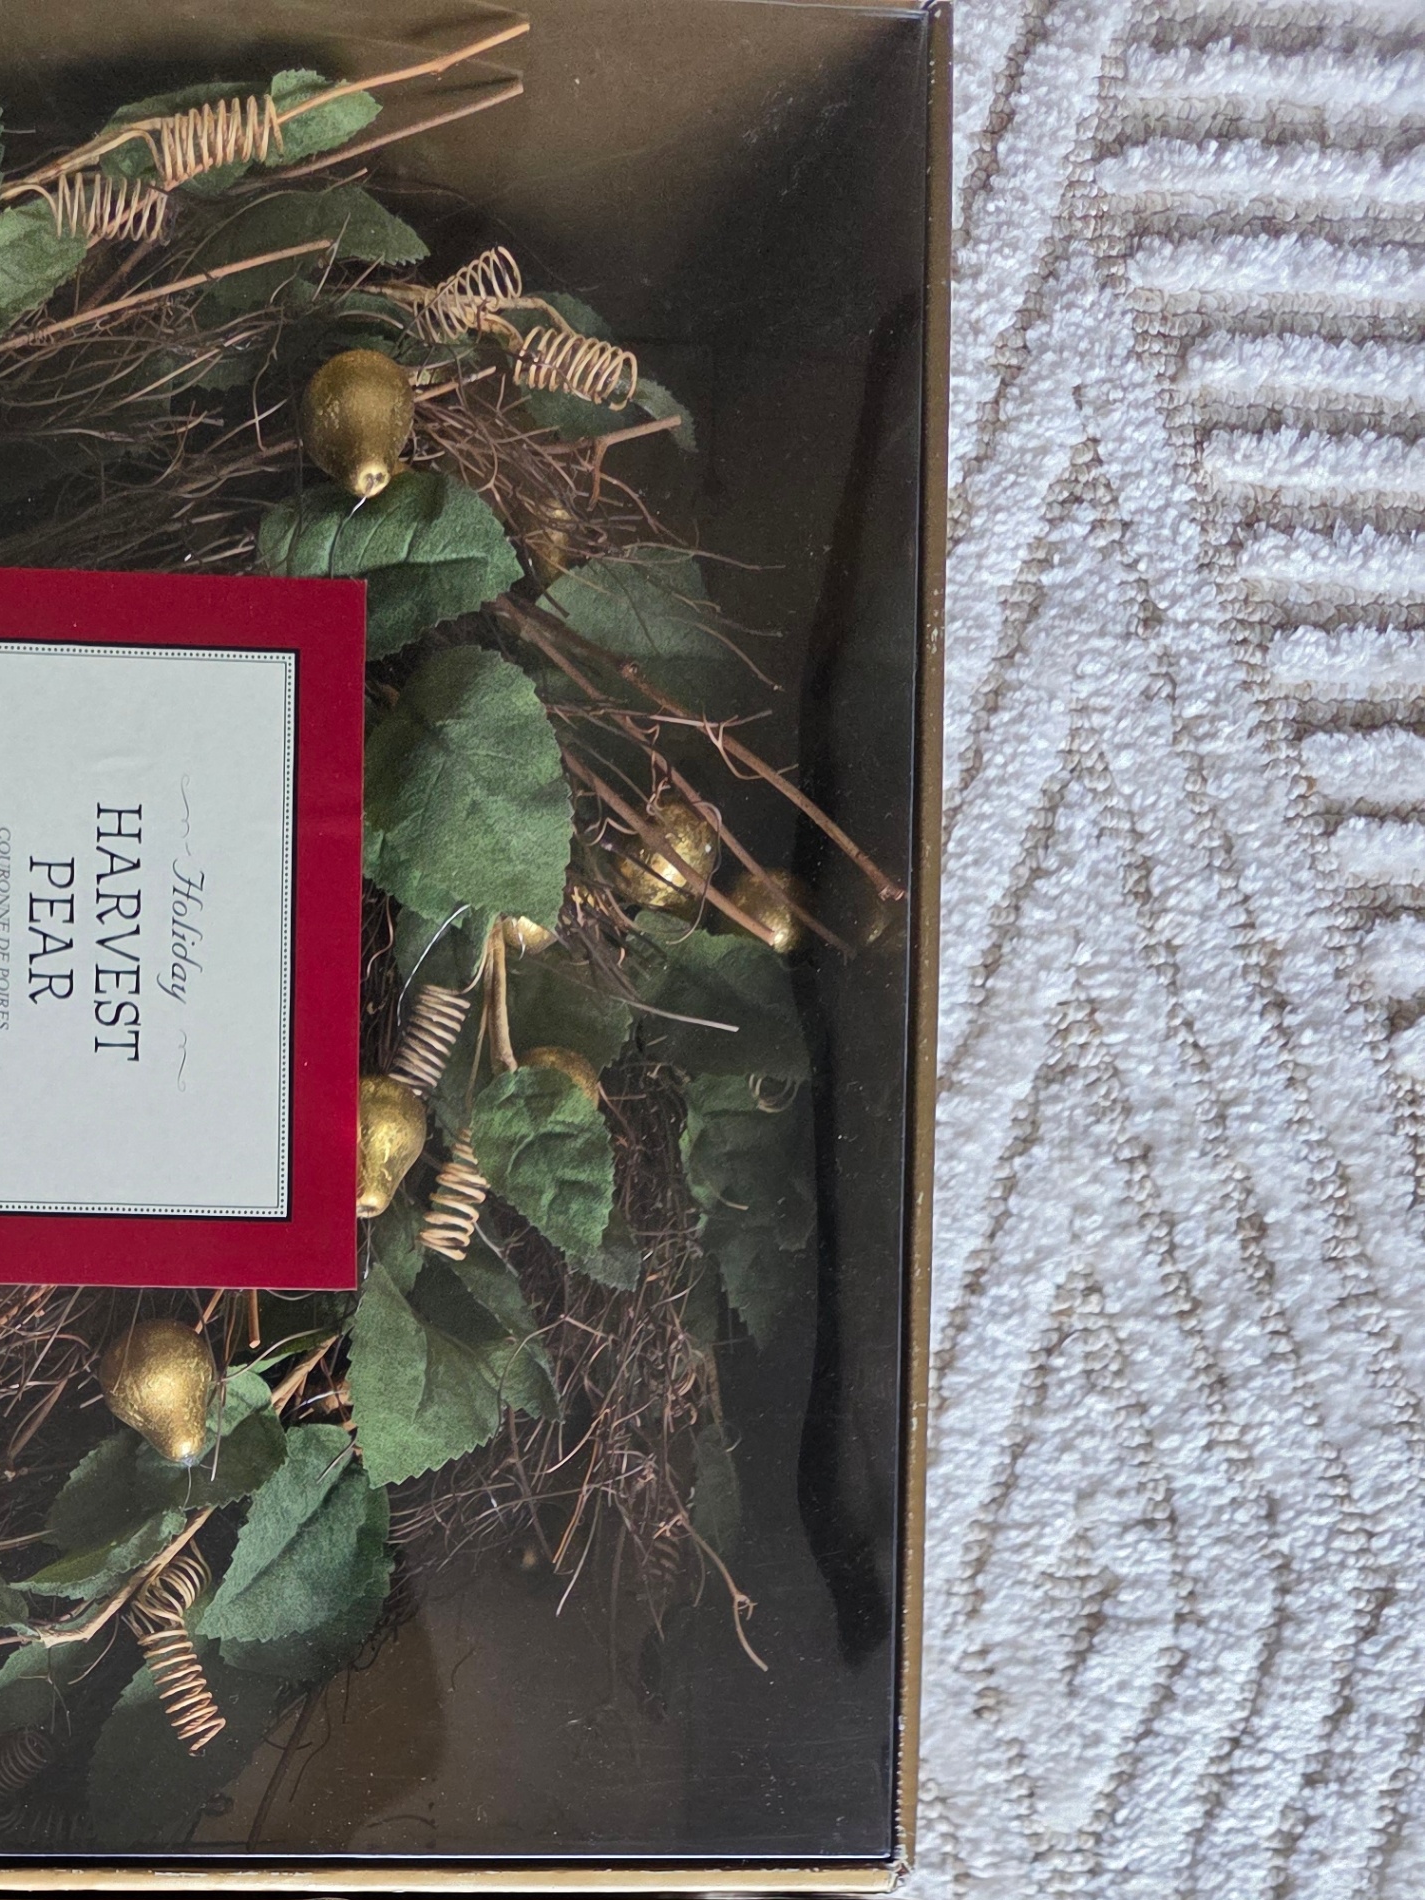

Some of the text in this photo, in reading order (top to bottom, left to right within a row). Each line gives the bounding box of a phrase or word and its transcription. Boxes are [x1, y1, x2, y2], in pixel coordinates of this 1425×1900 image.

[28, 855, 74, 1005] PEAR
[94, 802, 142, 1062] HARVEST
[157, 859, 204, 1004] Holiday
